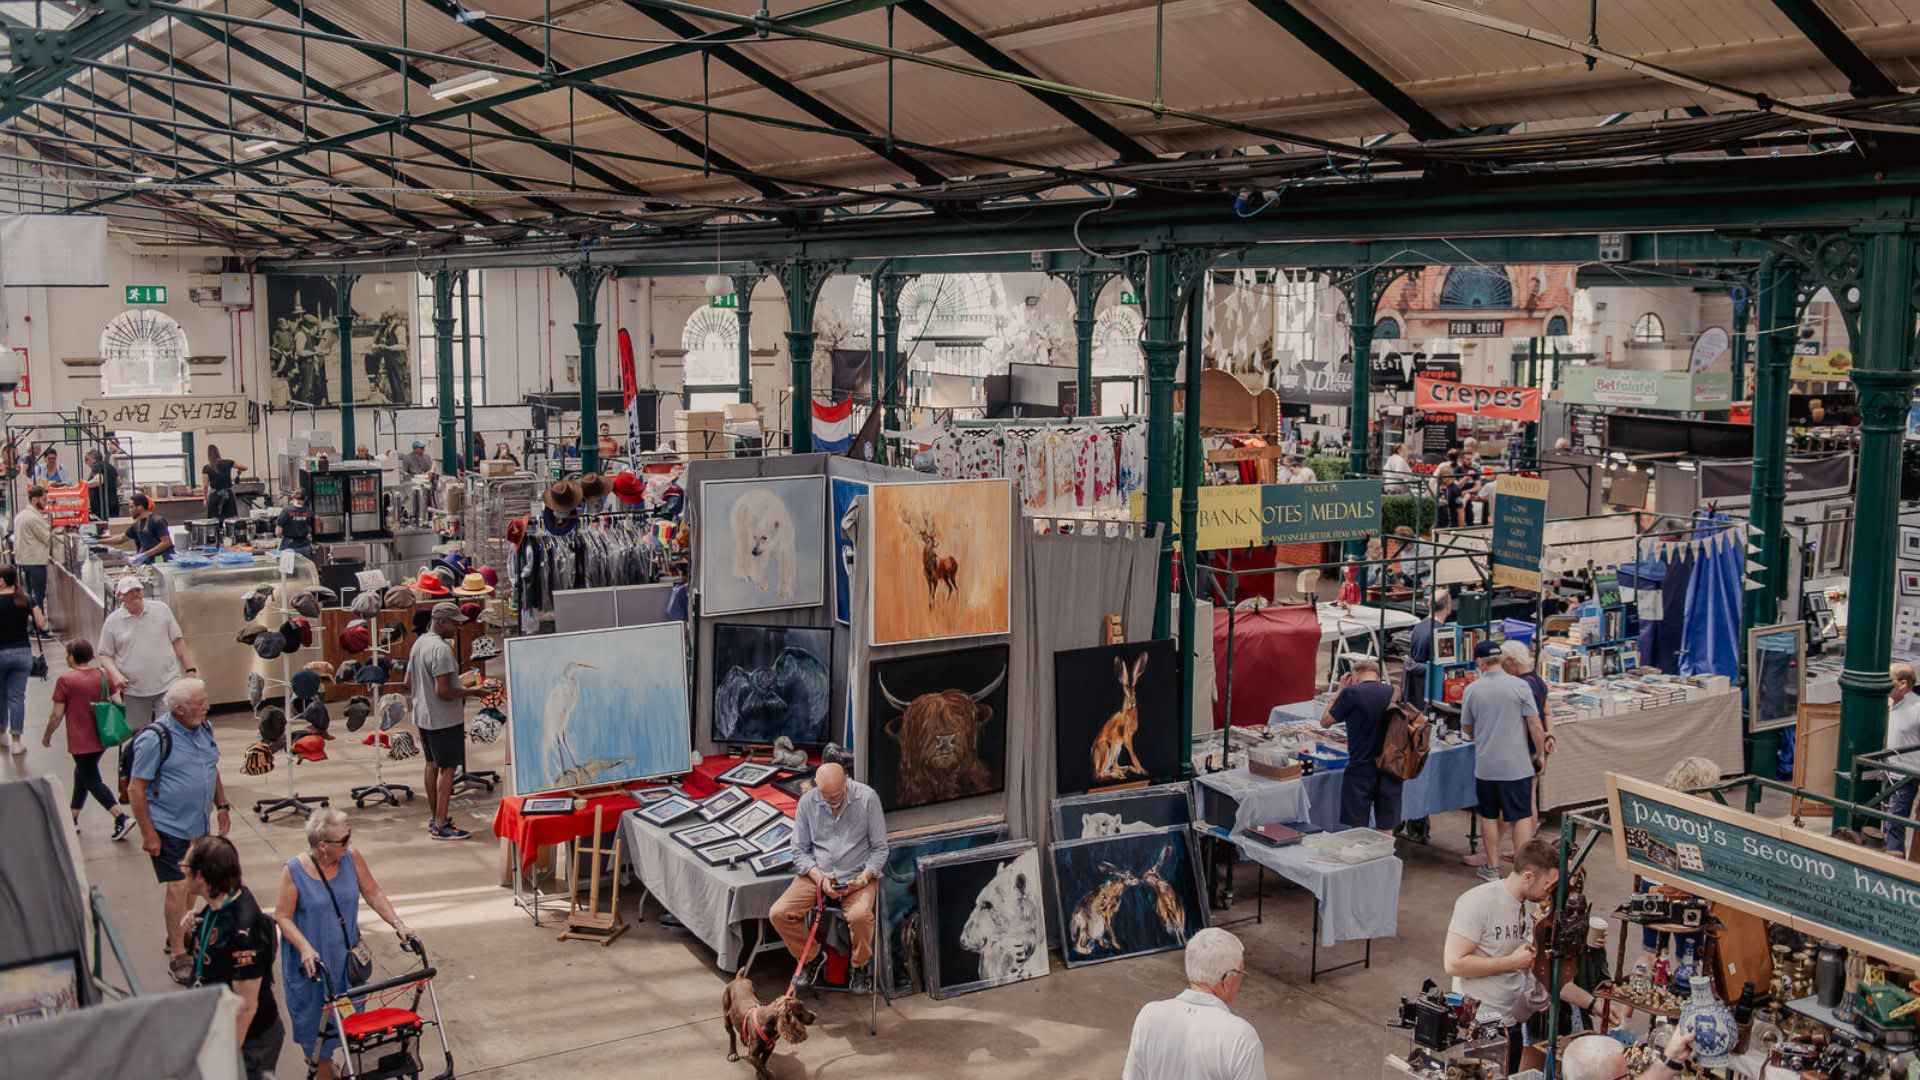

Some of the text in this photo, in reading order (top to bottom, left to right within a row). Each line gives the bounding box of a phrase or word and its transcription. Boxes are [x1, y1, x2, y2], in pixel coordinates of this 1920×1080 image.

[1451, 322, 1502, 334] FOOD COURT
[1431, 383, 1523, 412] crepes
[113, 403, 150, 423] BAP
[160, 401, 237, 421] BELFAST
[1200, 504, 1302, 528] BANKNOTES
[1311, 499, 1375, 522] MEDALS
